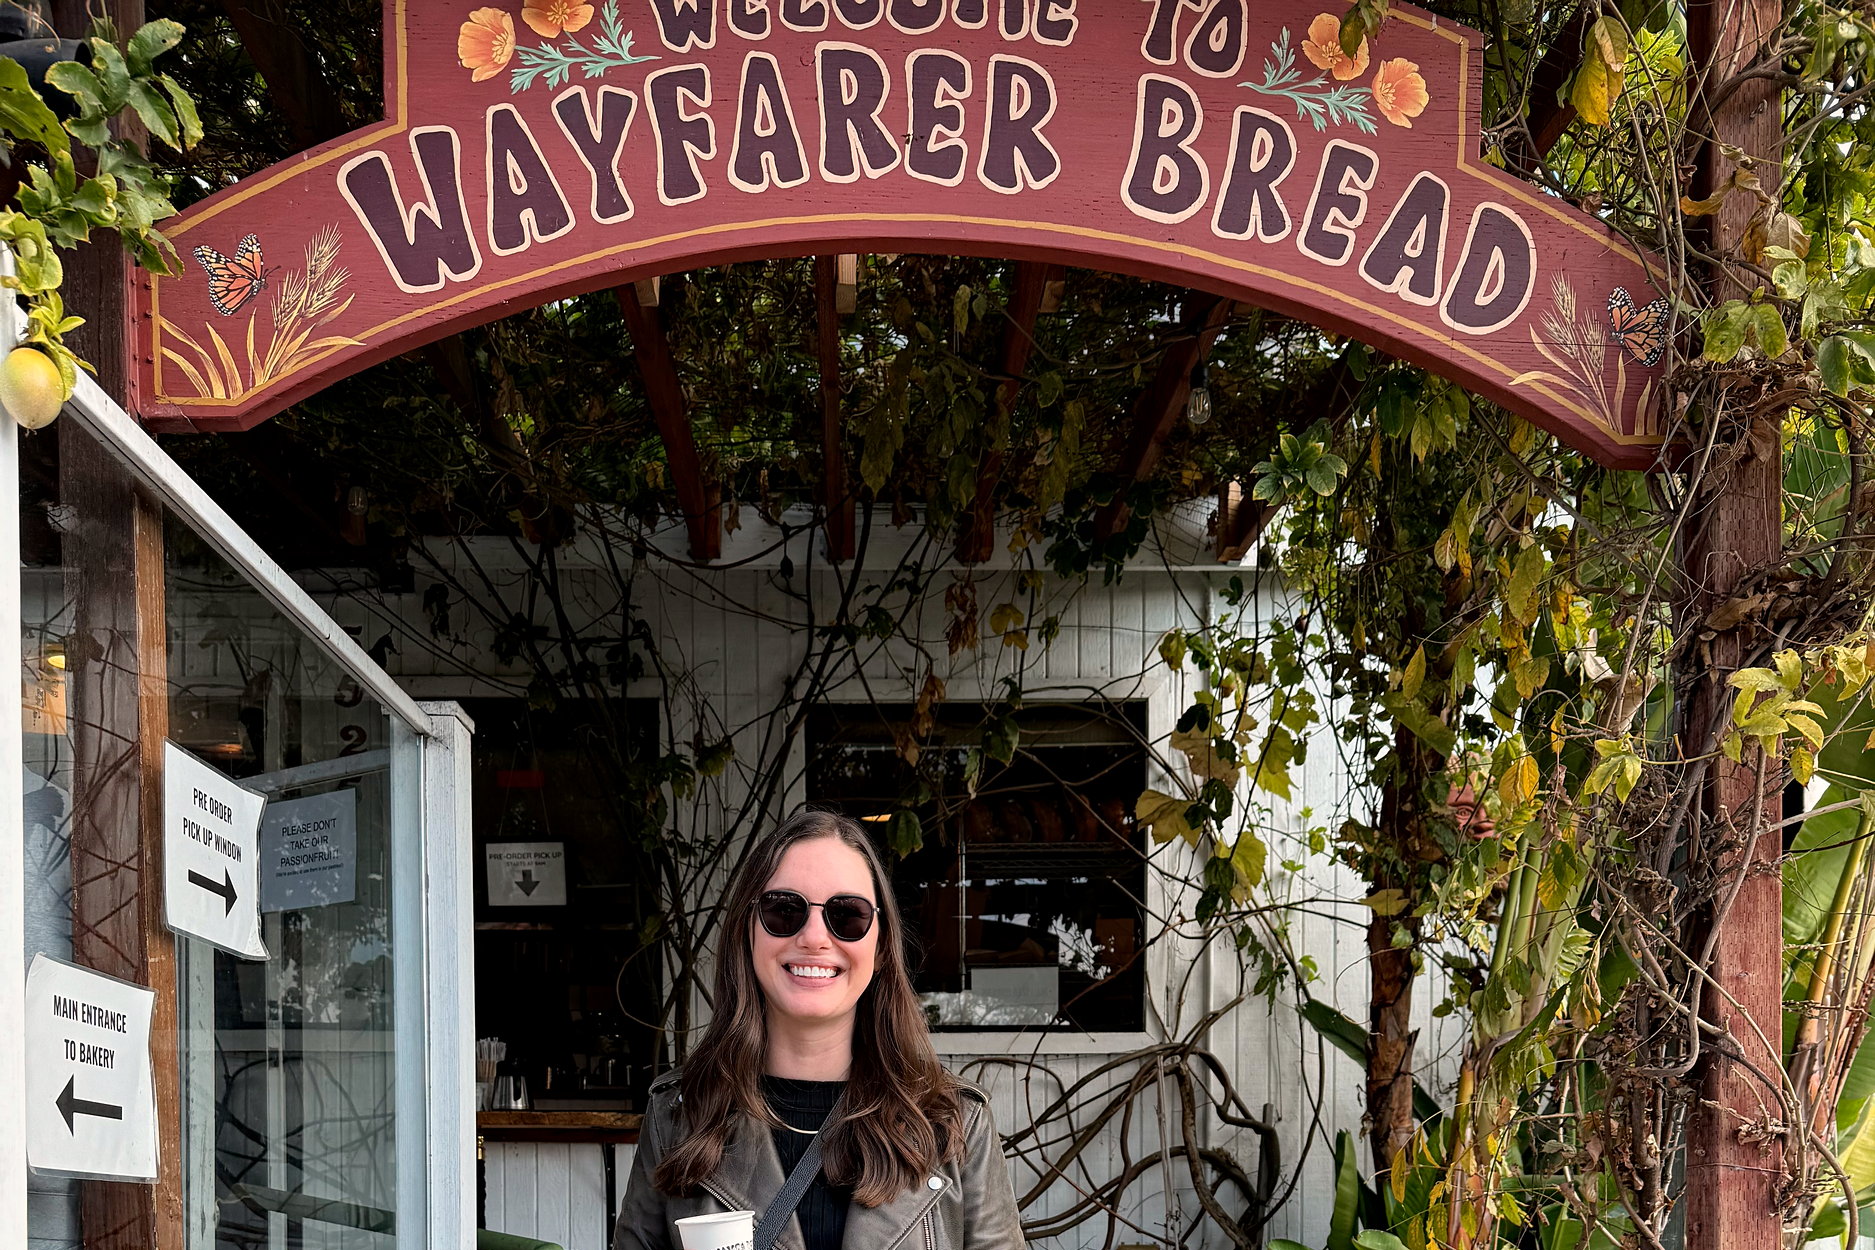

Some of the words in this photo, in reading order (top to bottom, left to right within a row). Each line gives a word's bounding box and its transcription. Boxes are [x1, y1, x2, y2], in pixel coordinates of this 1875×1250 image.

[336, 41, 1061, 294] WAYFARER
[1120, 72, 1538, 336] BREAD
[193, 787, 208, 812] PRE
[209, 796, 233, 826] ORDER
[183, 816, 201, 843] PICK
[202, 826, 213, 848] UP
[214, 832, 242, 863] WINDOW
[281, 822, 312, 837] PLEASE
[313, 818, 337, 832] DON'T
[290, 838, 310, 851] TAKE
[311, 835, 329, 847] OUR
[533, 851, 551, 859] PICK
[551, 851, 563, 859] UP
[53, 994, 79, 1021] MAIN
[81, 1002, 127, 1034] ENTRANCE
[64, 1038, 76, 1061] TO
[79, 1042, 115, 1069] BAKERY
